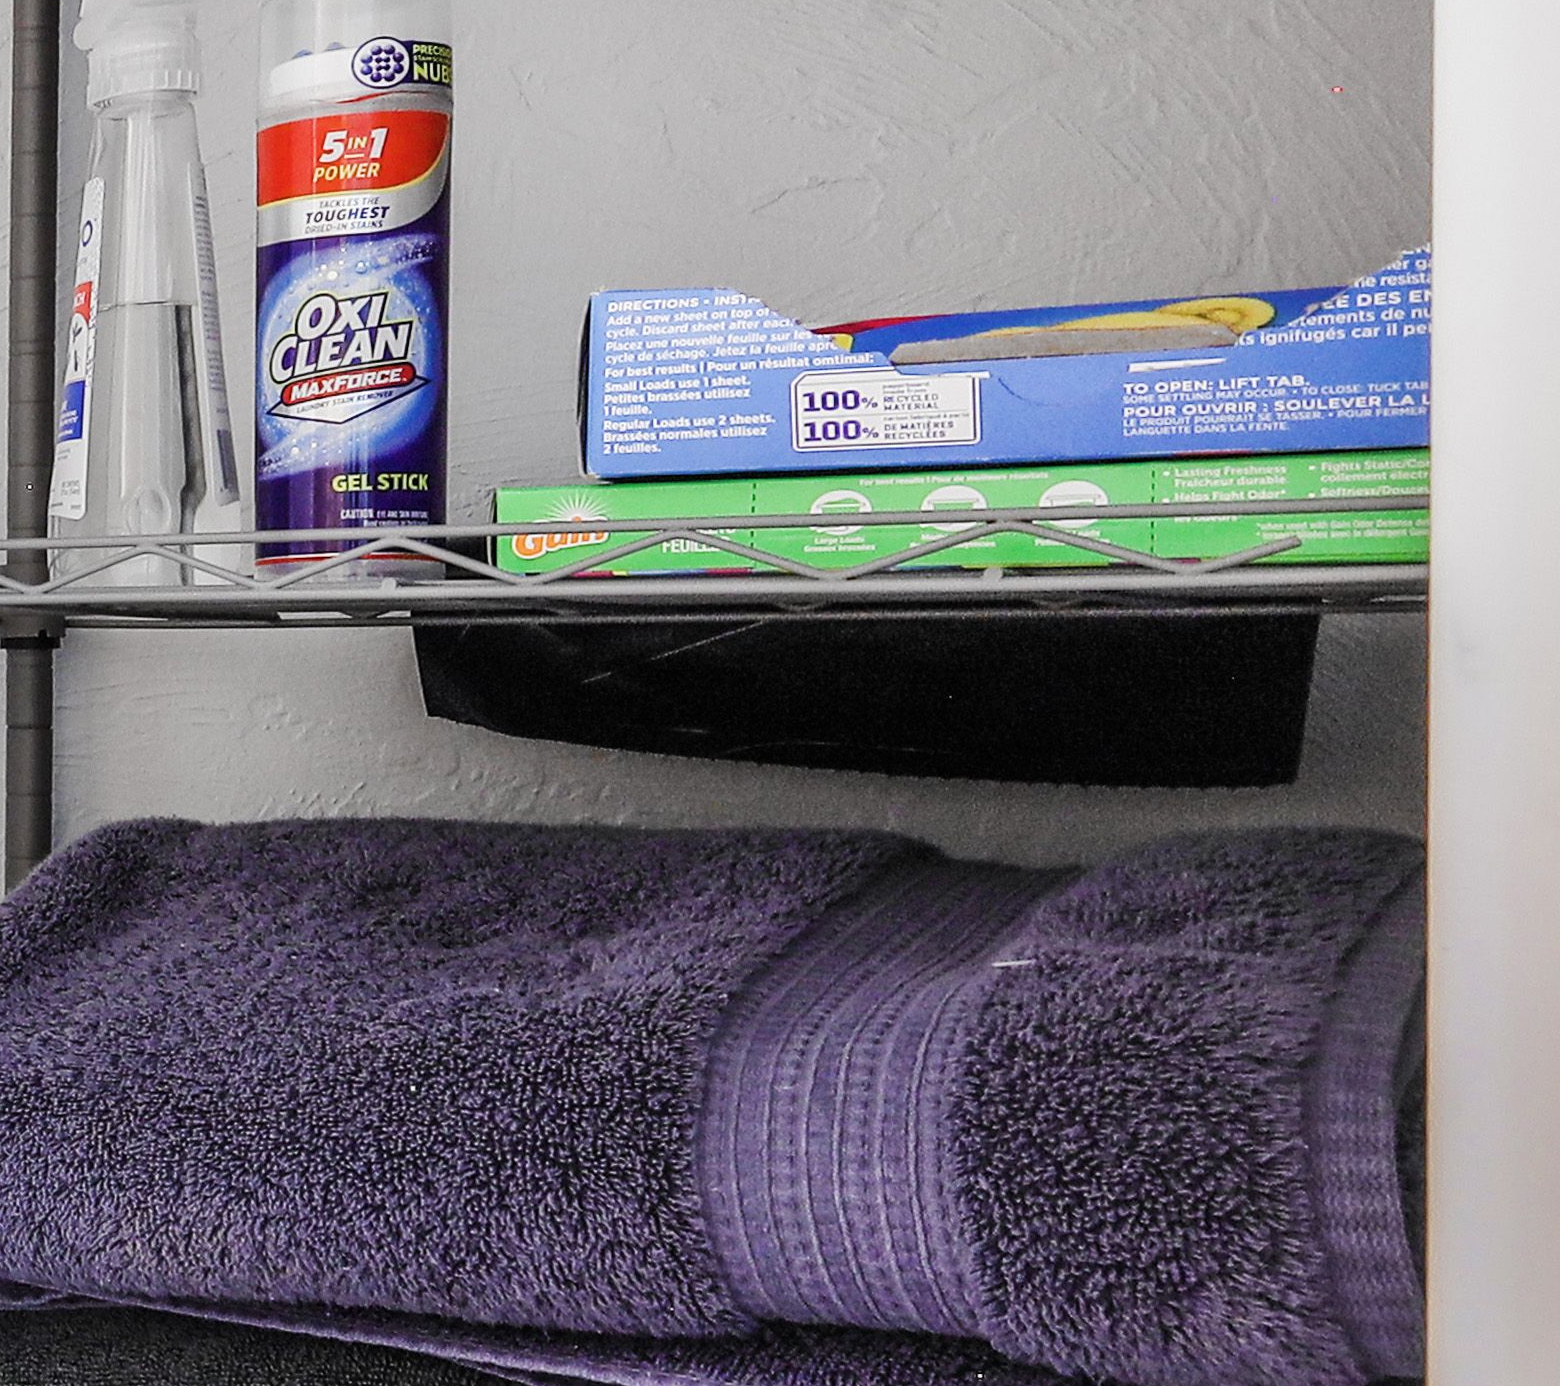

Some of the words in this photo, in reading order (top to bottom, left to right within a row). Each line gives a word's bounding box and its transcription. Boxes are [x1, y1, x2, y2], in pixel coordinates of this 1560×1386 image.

[414, 61, 452, 83] NUB
[319, 130, 347, 162] 5
[347, 136, 366, 150] IN
[369, 128, 388, 158] 1
[313, 163, 381, 182] POWER
[306, 206, 390, 224] TOUGHEST
[608, 297, 698, 312] DIRECTIONS
[1357, 292, 1400, 306] DES
[296, 293, 389, 340] OXI
[1261, 328, 1345, 346] ignifugés
[1352, 327, 1379, 338] car
[271, 321, 412, 384] CLEAN
[291, 370, 404, 401] MAXFORCE
[605, 381, 636, 392] Small
[640, 379, 675, 389] Loads
[678, 380, 700, 388] use
[711, 376, 751, 386] sheet.
[1123, 383, 1148, 394] TO
[1155, 380, 1213, 393] OPEN:
[1220, 378, 1260, 390] LIFT
[1267, 375, 1310, 387] TAB.
[803, 391, 878, 412] 100%
[1124, 405, 1176, 417] POUR
[1182, 402, 1256, 415] OUVRIR
[1275, 397, 1381, 411] SOULEVER
[1388, 395, 1415, 406] LA
[604, 419, 650, 431] Regular
[653, 418, 690, 428] Loads
[693, 417, 714, 425] use
[719, 416, 726, 424] 2
[804, 421, 879, 442] 100%
[332, 474, 373, 491] GEL
[377, 473, 428, 491] STICK
